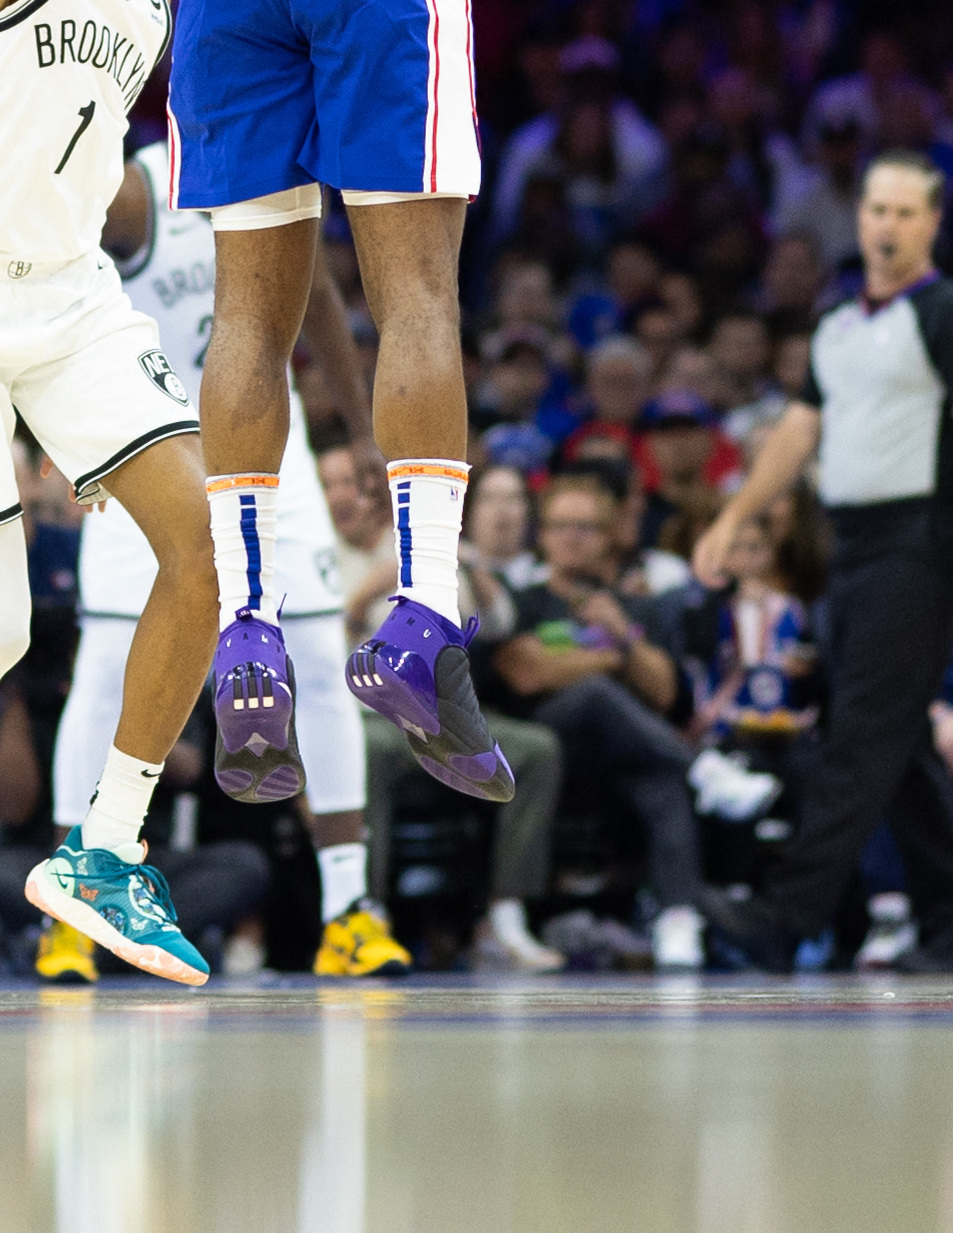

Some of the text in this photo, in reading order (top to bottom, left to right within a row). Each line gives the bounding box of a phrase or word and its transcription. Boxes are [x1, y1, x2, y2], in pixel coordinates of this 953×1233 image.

[34, 19, 146, 111] BROOKLYN
[54, 100, 96, 175] 1
[152, 259, 215, 309] BRO
